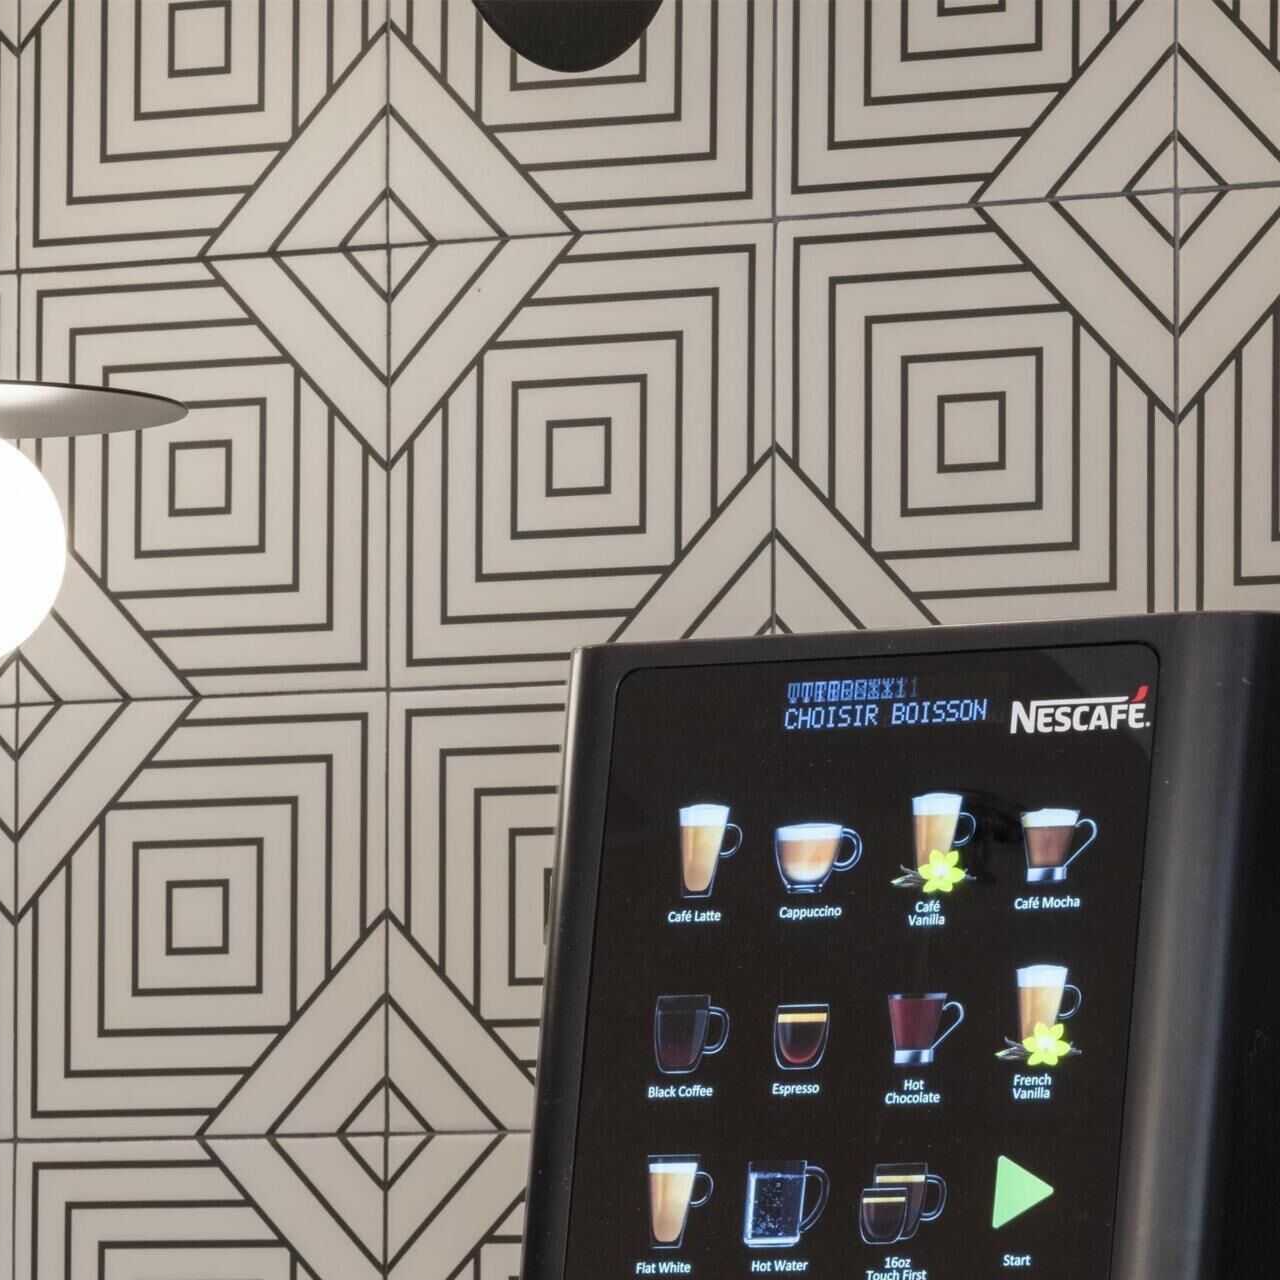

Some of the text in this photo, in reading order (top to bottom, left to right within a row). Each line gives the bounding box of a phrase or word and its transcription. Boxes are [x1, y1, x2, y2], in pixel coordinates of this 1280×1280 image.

[784, 698, 988, 730] CHOISIR BOISSON
[915, 900, 940, 914] Café
[1014, 896, 1080, 910] Café Mocha
[668, 909, 721, 923] Café Latte
[779, 905, 842, 920] Cappuccino
[908, 914, 945, 927] Vanilla
[904, 1079, 924, 1091] Hot
[1013, 1074, 1051, 1087] French
[648, 1085, 713, 1098] Black Coffee
[772, 1083, 820, 1097] Espresso
[1013, 1087, 1050, 1100] Vanilla
[885, 1091, 940, 1104] Chocolate
[752, 1259, 808, 1272] Hot Water
[885, 1257, 911, 1269] 16oz
[1003, 1254, 1031, 1267] Start
[636, 1261, 691, 1274] Flat White
[898, 1269, 927, 1280] First
